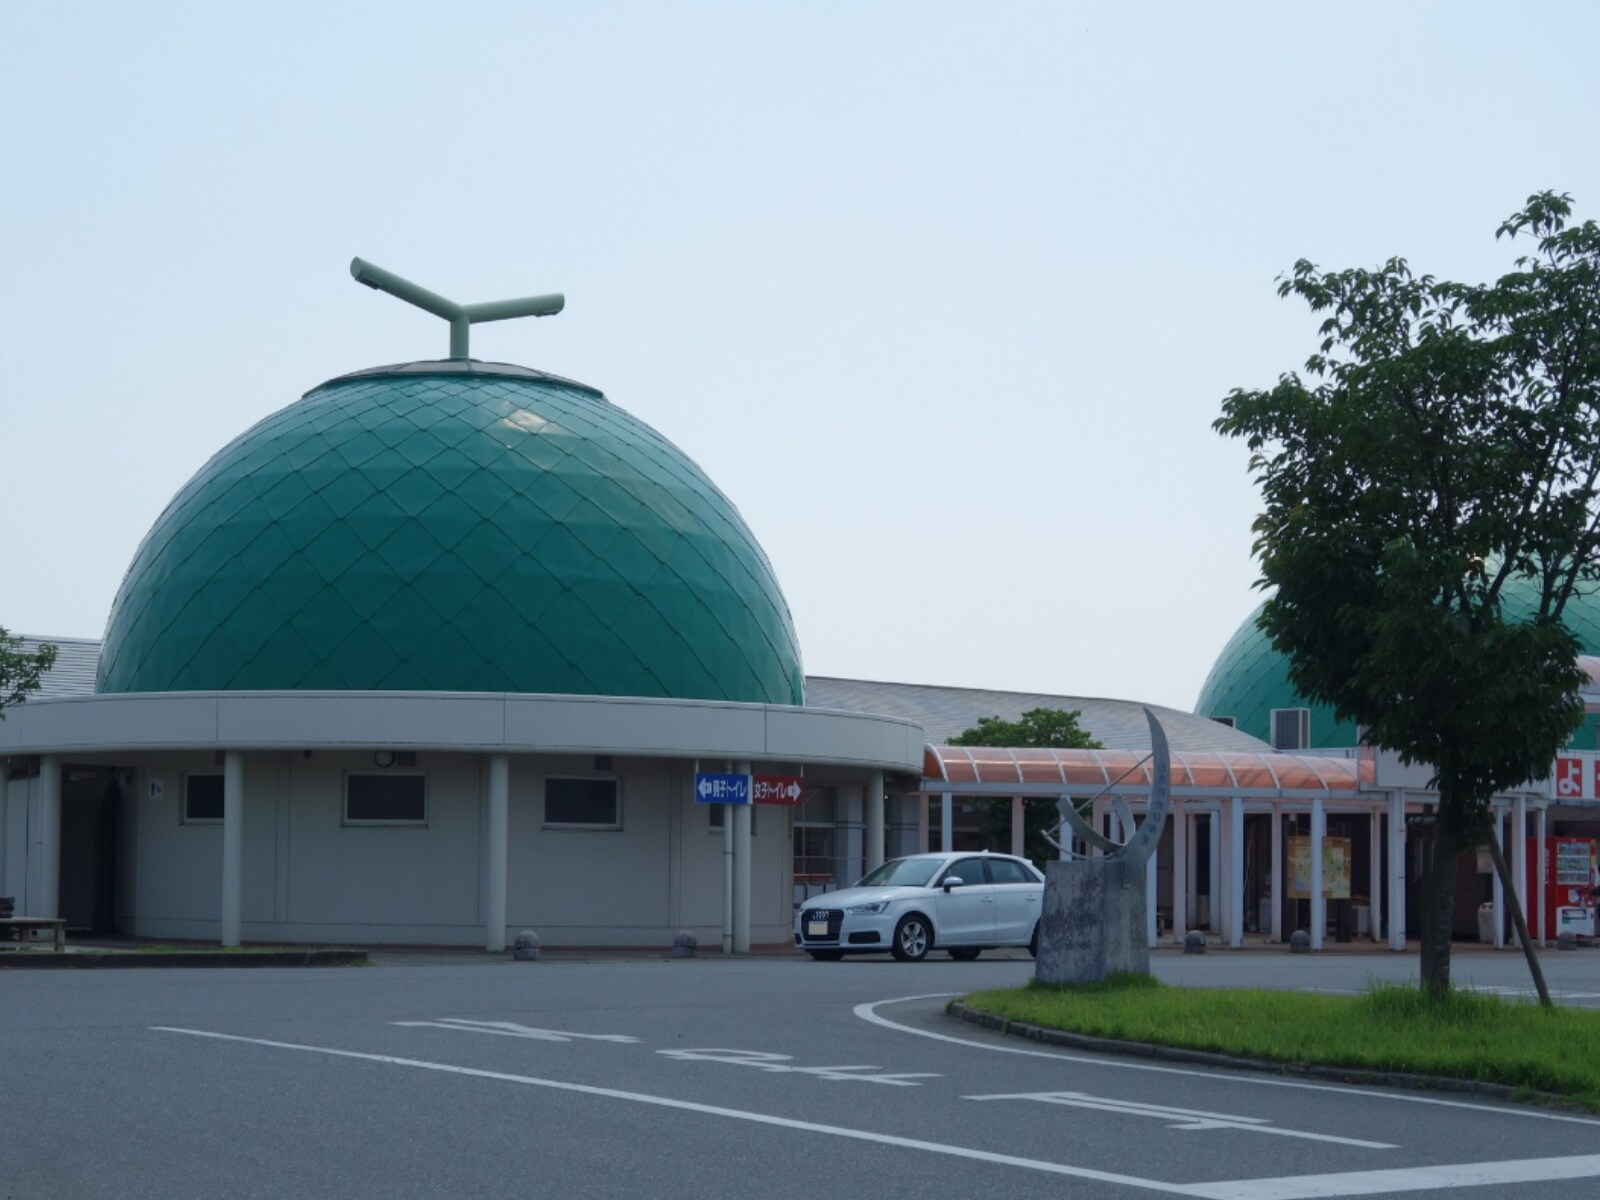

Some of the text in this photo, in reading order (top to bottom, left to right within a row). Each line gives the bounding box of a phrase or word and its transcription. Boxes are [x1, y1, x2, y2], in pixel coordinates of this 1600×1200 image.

[712, 779, 748, 798] 男子トイレ
[753, 781, 788, 799] 女子トイレ
